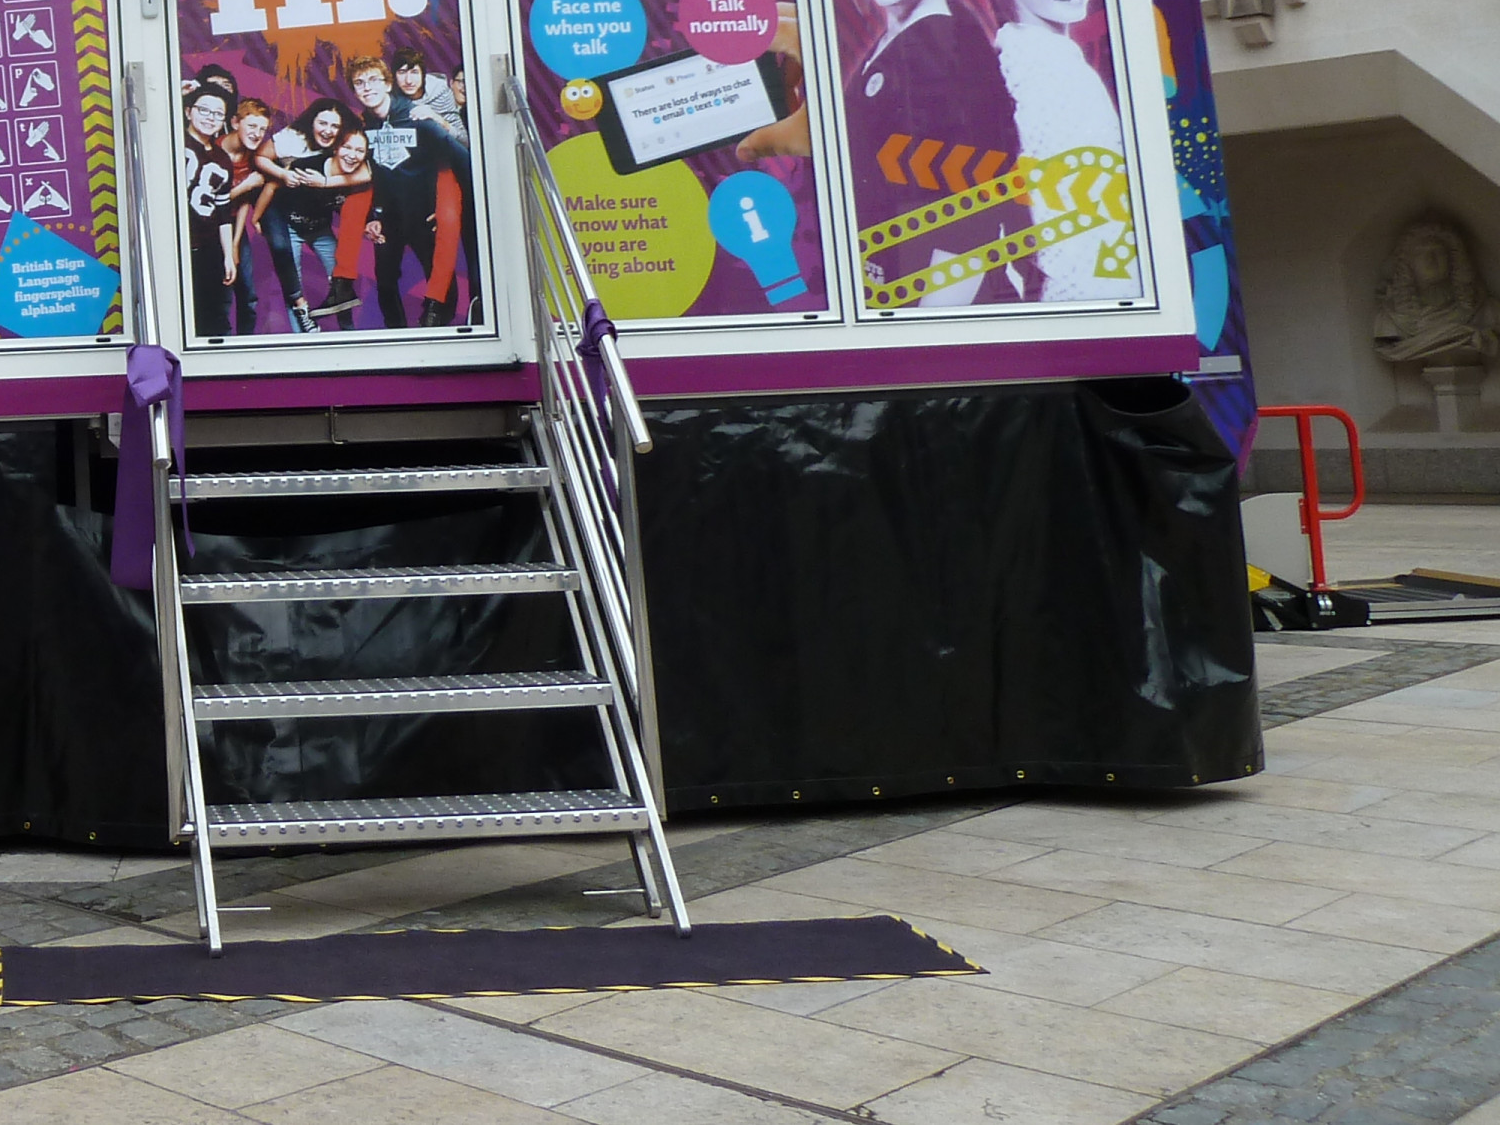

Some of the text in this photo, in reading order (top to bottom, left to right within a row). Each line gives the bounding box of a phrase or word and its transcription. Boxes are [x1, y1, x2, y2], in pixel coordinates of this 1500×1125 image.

[552, 0, 621, 14] Face me
[545, 19, 631, 37] when you
[689, 15, 769, 35] normally
[573, 38, 608, 55] talk
[632, 78, 752, 118] There are lots of ways to chat
[662, 93, 740, 121] email text sign
[565, 194, 657, 211] Make sure
[622, 214, 668, 230] what
[581, 239, 647, 257] you are
[12, 258, 85, 273] British Sign
[623, 256, 676, 273] about
[18, 275, 80, 287] Language
[14, 286, 100, 303] fingerspelling
[21, 302, 76, 318] alphabet
